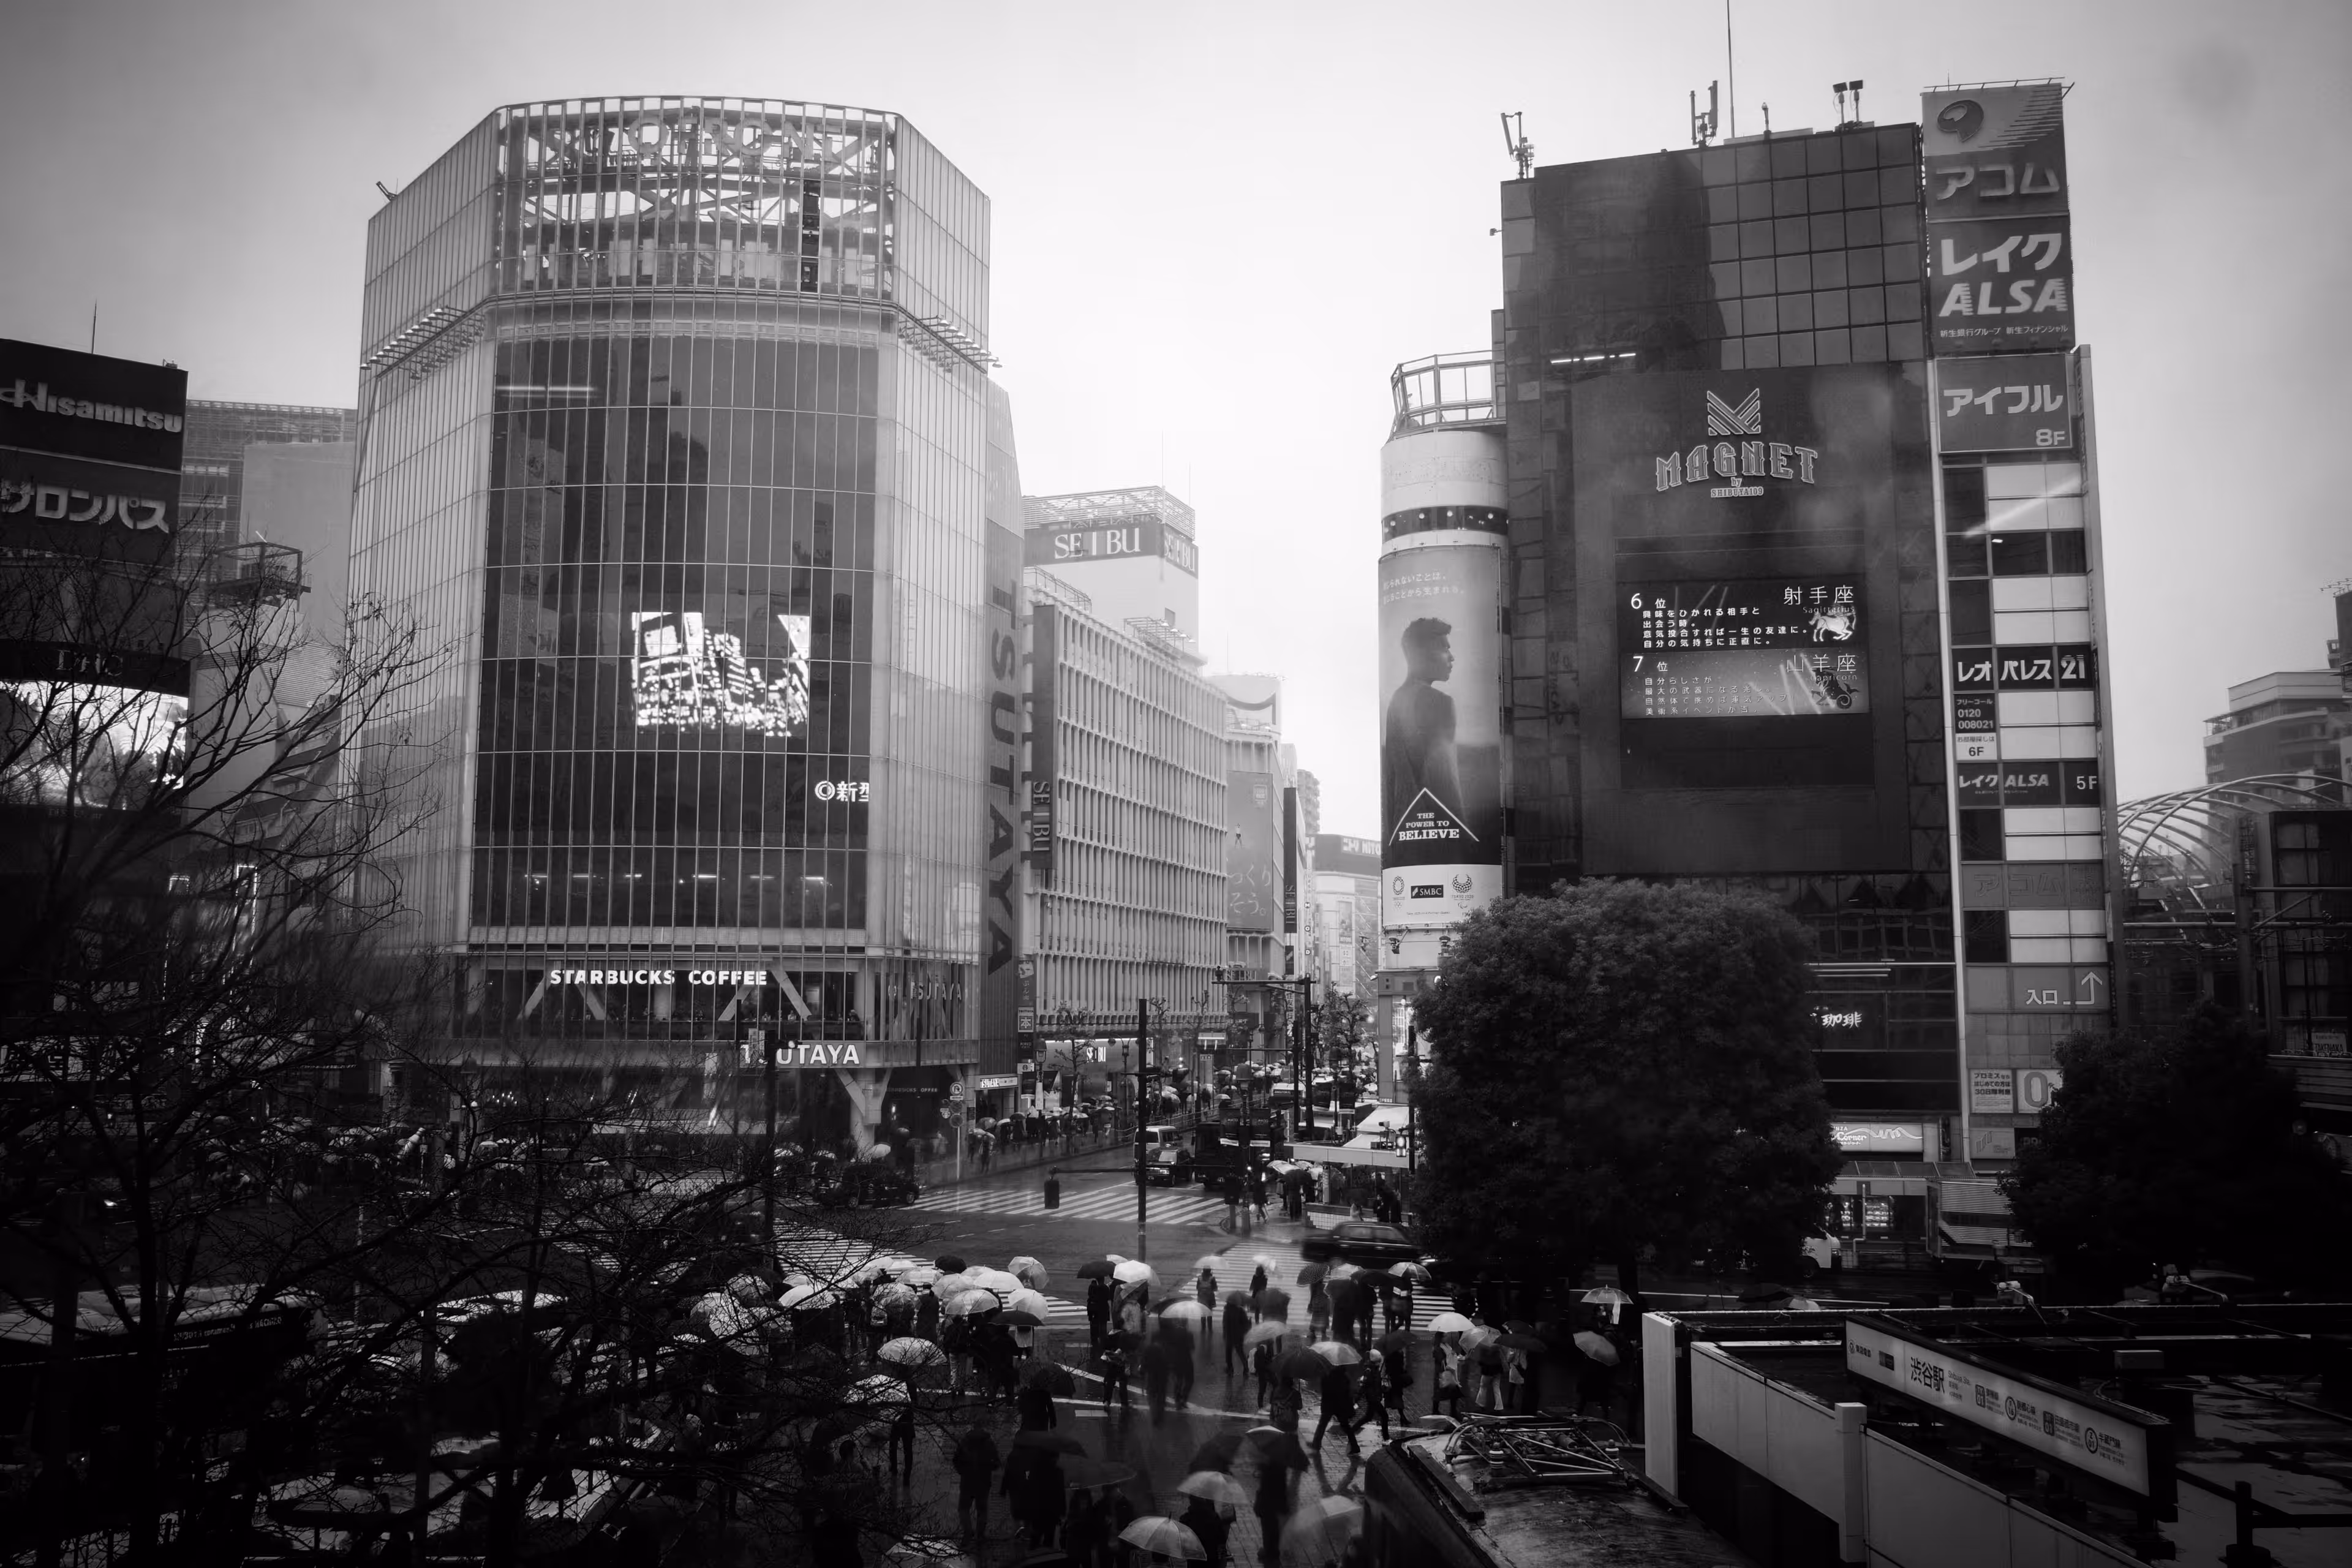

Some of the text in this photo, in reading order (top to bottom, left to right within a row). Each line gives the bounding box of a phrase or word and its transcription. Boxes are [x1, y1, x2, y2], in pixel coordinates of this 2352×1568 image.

[1936, 162, 2060, 200] アコム
[1941, 232, 2062, 276] レイク
[1939, 277, 2068, 317] ALSA
[0, 377, 183, 432] Hisamitsu
[1943, 385, 2064, 417] アイフル
[2035, 428, 2067, 446] 8F
[1656, 441, 1818, 492] MAGNET
[1730, 477, 1743, 488] by
[1711, 487, 1764, 498] SHIBUYA109
[1054, 528, 1142, 560] SEIBU
[1783, 584, 1854, 605] 射手座
[1643, 607, 1760, 619] 興味をひかれる相手と
[1643, 619, 1695, 628] 出会う時。
[1643, 637, 1770, 649] 自分の気持ちに正直に。
[1787, 653, 1856, 673] 山羊座
[1958, 708, 1981, 718] 0120
[1958, 720, 1994, 729] 008021
[1969, 747, 1985, 757] 6F
[988, 580, 1017, 975] TSUTAYA
[1959, 774, 2097, 790] レイク ALSA 5F
[1032, 781, 1050, 852] SEIBU
[1398, 829, 1460, 841] BELIEVE
[1420, 888, 1442, 897] SMBC
[1973, 872, 2062, 898] アコム
[550, 969, 767, 986] STARBUCKS COFFEE
[2026, 988, 2058, 1005] 入口
[1020, 1017, 1031, 1029] 本
[739, 1043, 861, 1065] TUTAYA
[1838, 1131, 1868, 1141] Corner
[1910, 1356, 1946, 1394] 渋谷駅
